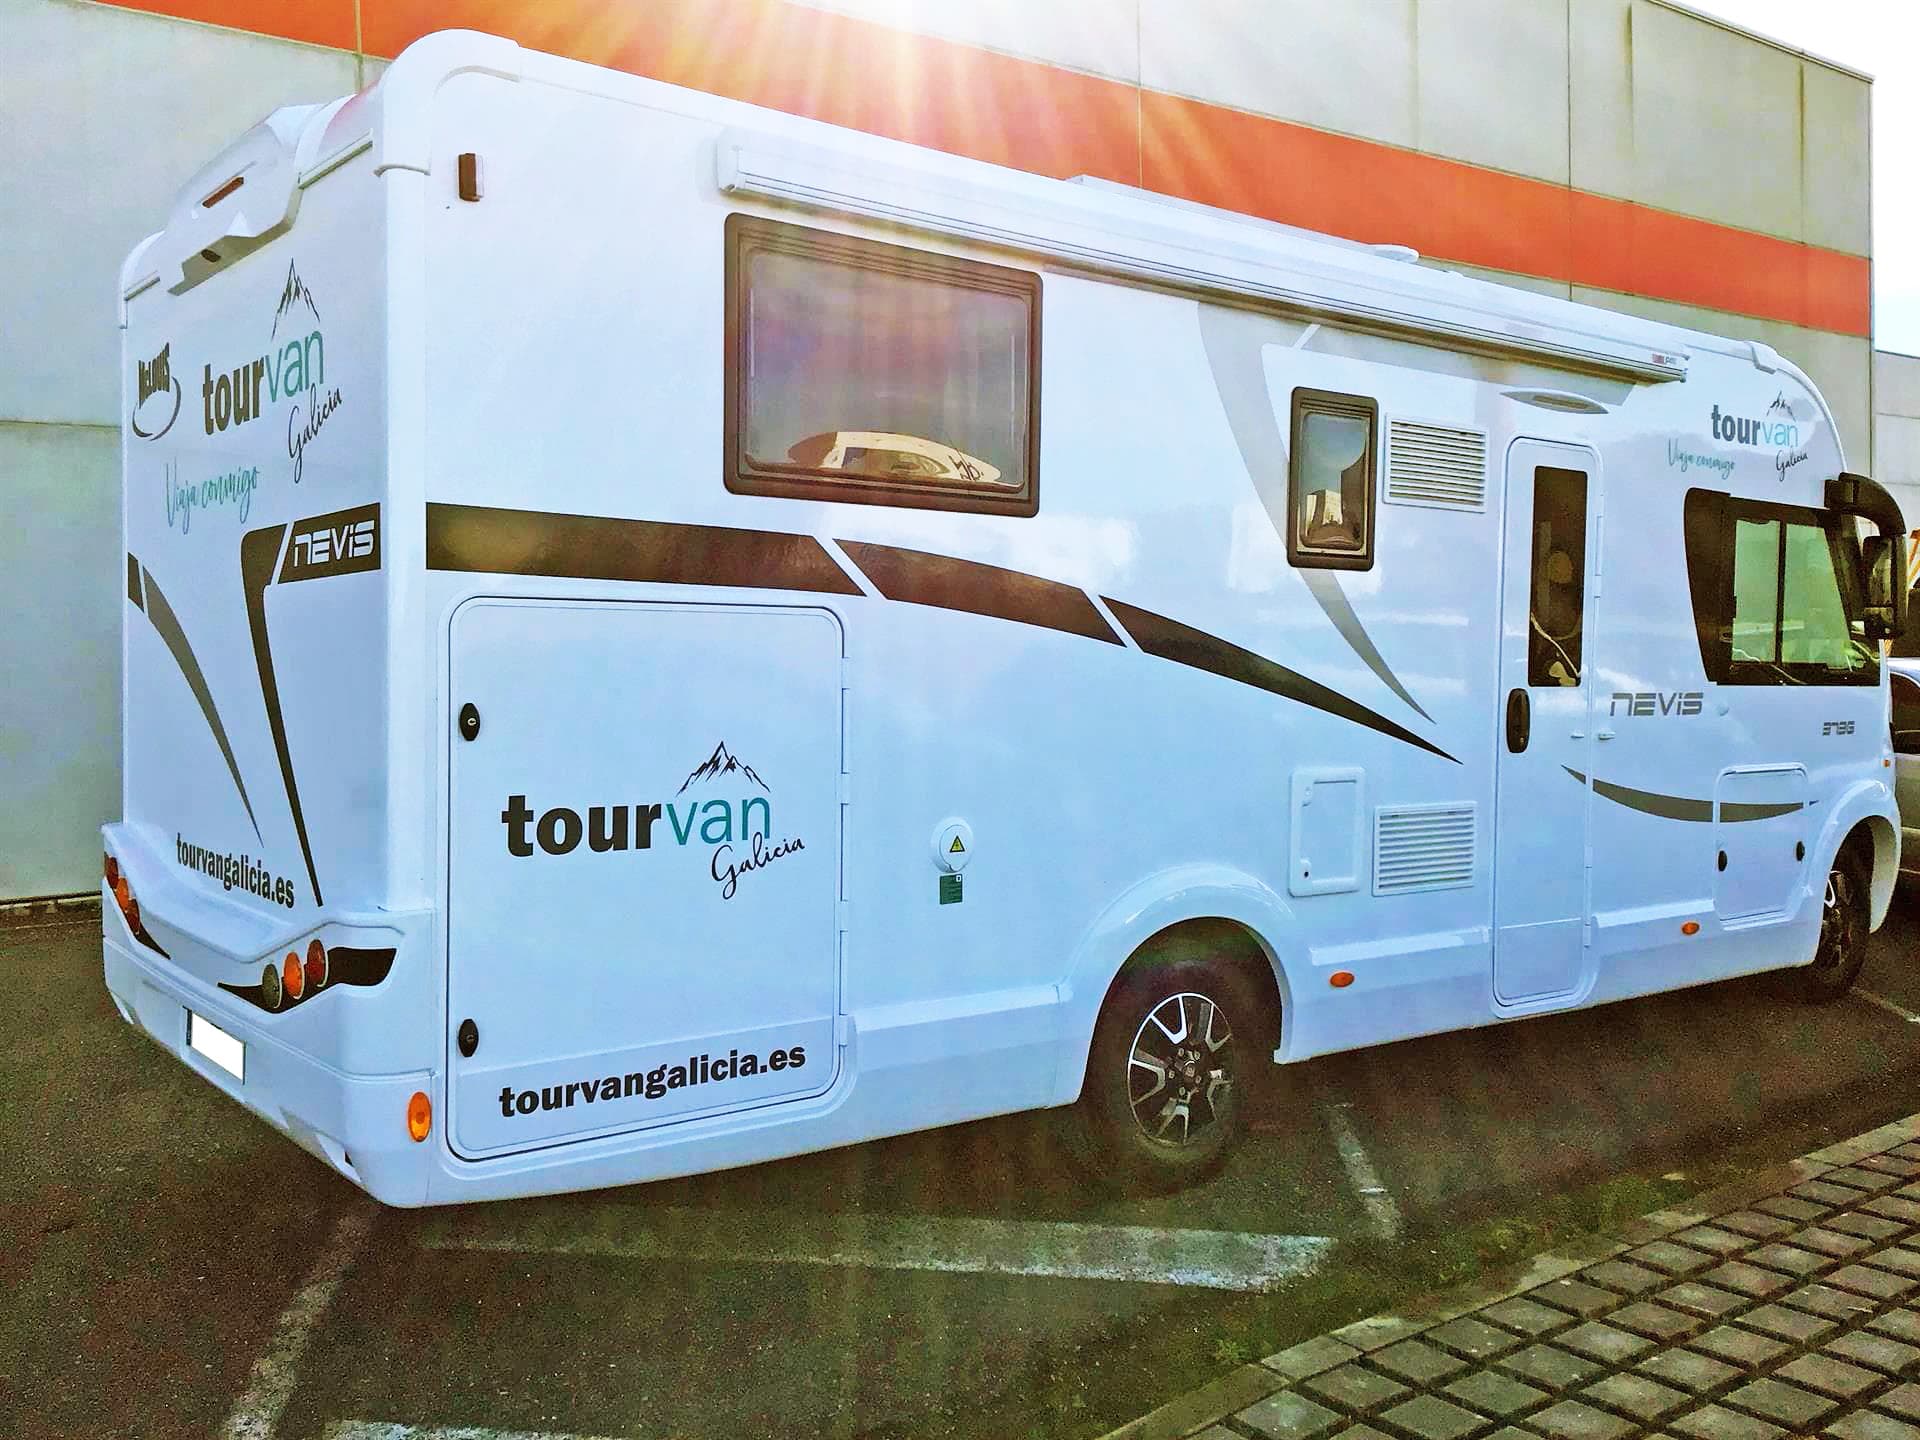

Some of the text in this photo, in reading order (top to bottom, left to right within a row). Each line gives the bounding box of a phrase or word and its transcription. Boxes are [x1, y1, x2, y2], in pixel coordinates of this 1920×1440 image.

[203, 330, 324, 435] tourvan
[288, 382, 343, 484] Galicia
[1711, 404, 1799, 447] tourvan
[166, 456, 260, 535] Viaja conmigo
[1776, 446, 1808, 482] Galicia
[501, 794, 771, 857] tourvan
[176, 832, 295, 908] tourvangalicia.es
[711, 831, 806, 900] Galicia
[499, 1045, 807, 1118] tourvangalicia.es
